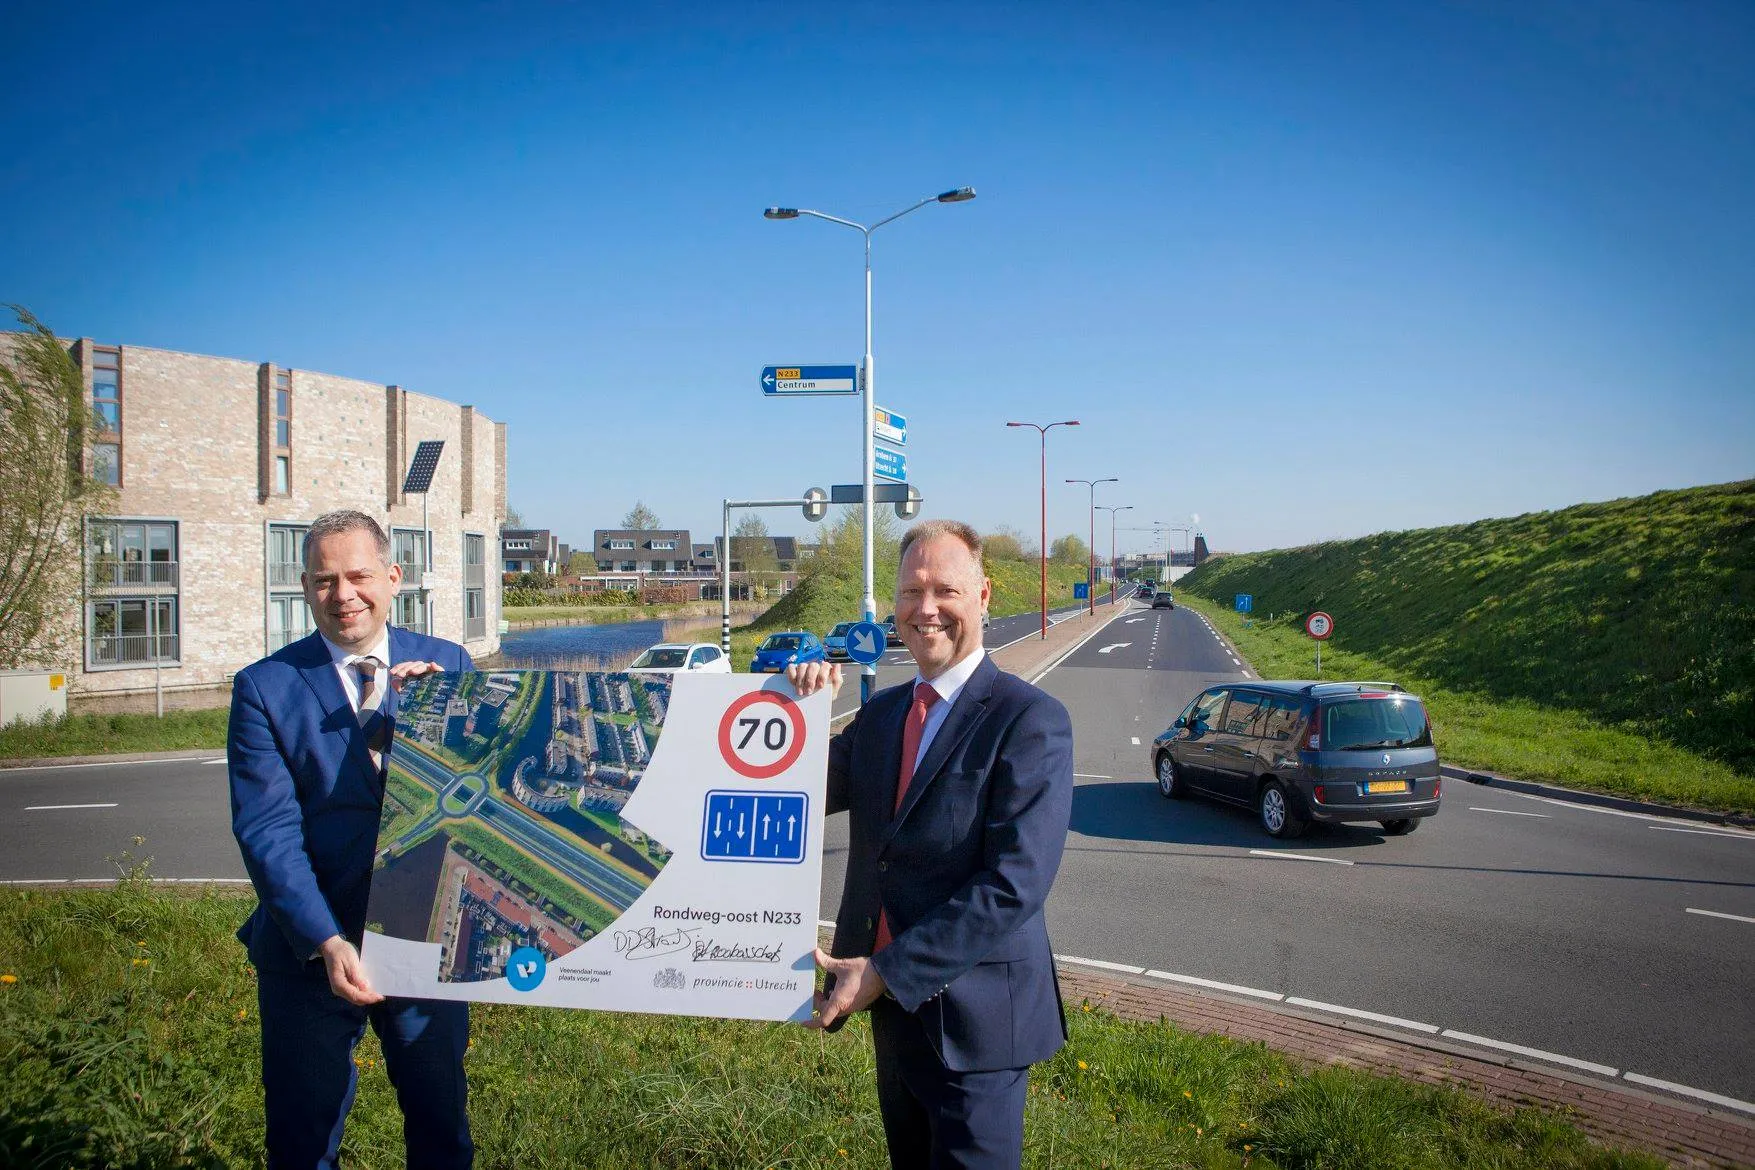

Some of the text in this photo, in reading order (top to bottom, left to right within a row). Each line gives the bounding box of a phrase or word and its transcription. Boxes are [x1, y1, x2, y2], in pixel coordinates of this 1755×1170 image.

[778, 370, 799, 378] N233
[777, 381, 816, 389] Centrum
[737, 718, 787, 751] 70
[653, 905, 802, 925] Rondweg-oost N233
[559, 966, 593, 975] Veenendaal
[692, 977, 798, 990] provincie Utrecht
